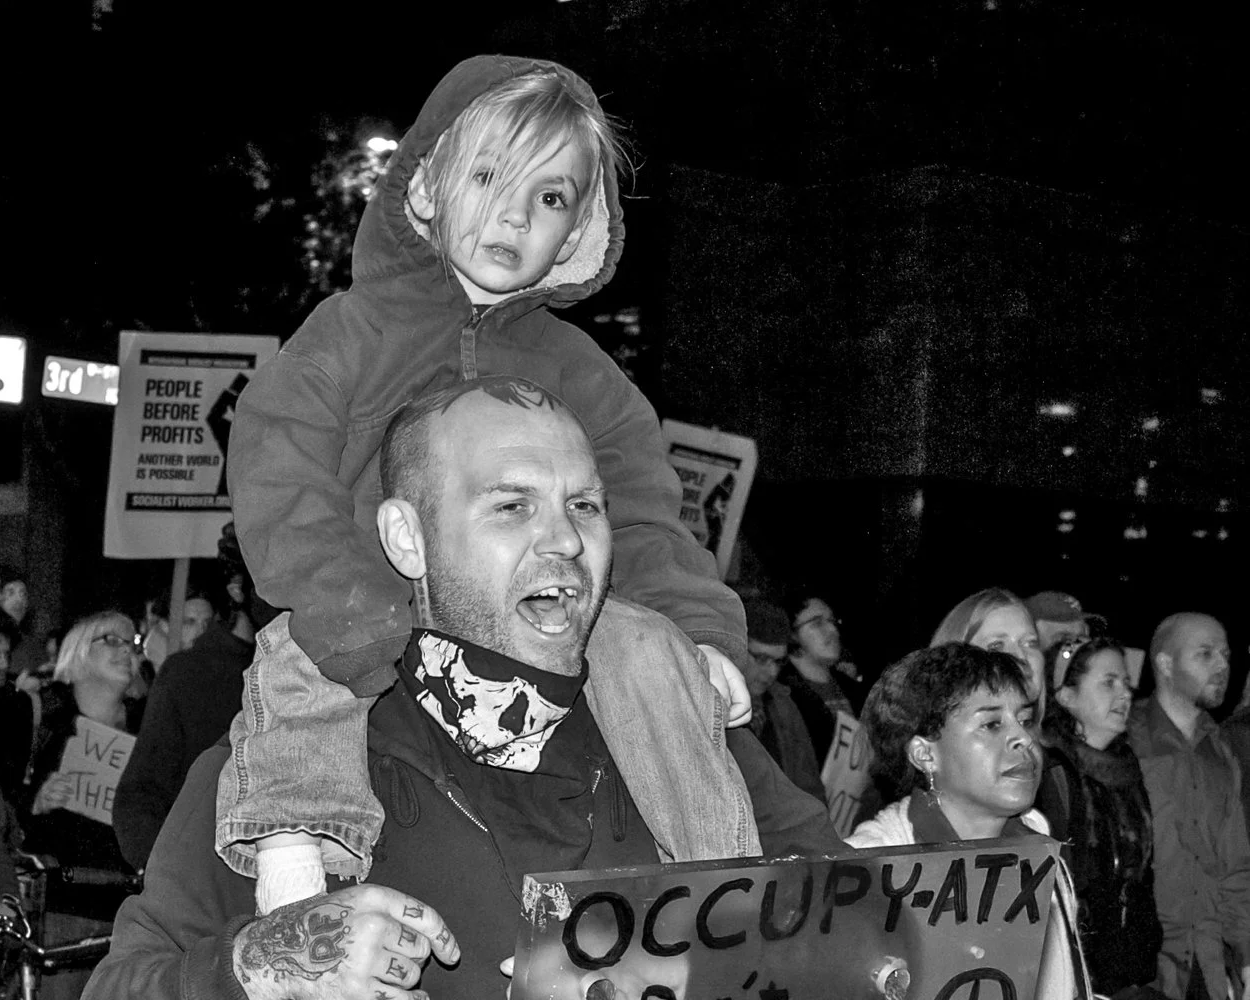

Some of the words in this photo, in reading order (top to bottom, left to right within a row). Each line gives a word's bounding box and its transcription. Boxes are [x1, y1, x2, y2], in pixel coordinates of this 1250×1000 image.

[45, 361, 84, 395] 3rd
[144, 378, 203, 399] PEOPLE
[143, 402, 200, 422] BEFORE
[140, 425, 204, 445] PROFITS
[137, 453, 183, 467] ANOTHER
[186, 454, 220, 467] WORLD
[136, 469, 146, 480] IS
[149, 469, 195, 481] POSSIBLE
[84, 728, 126, 770] WE
[67, 770, 115, 811] THE
[562, 853, 1055, 971] OCCUPY-ATX
